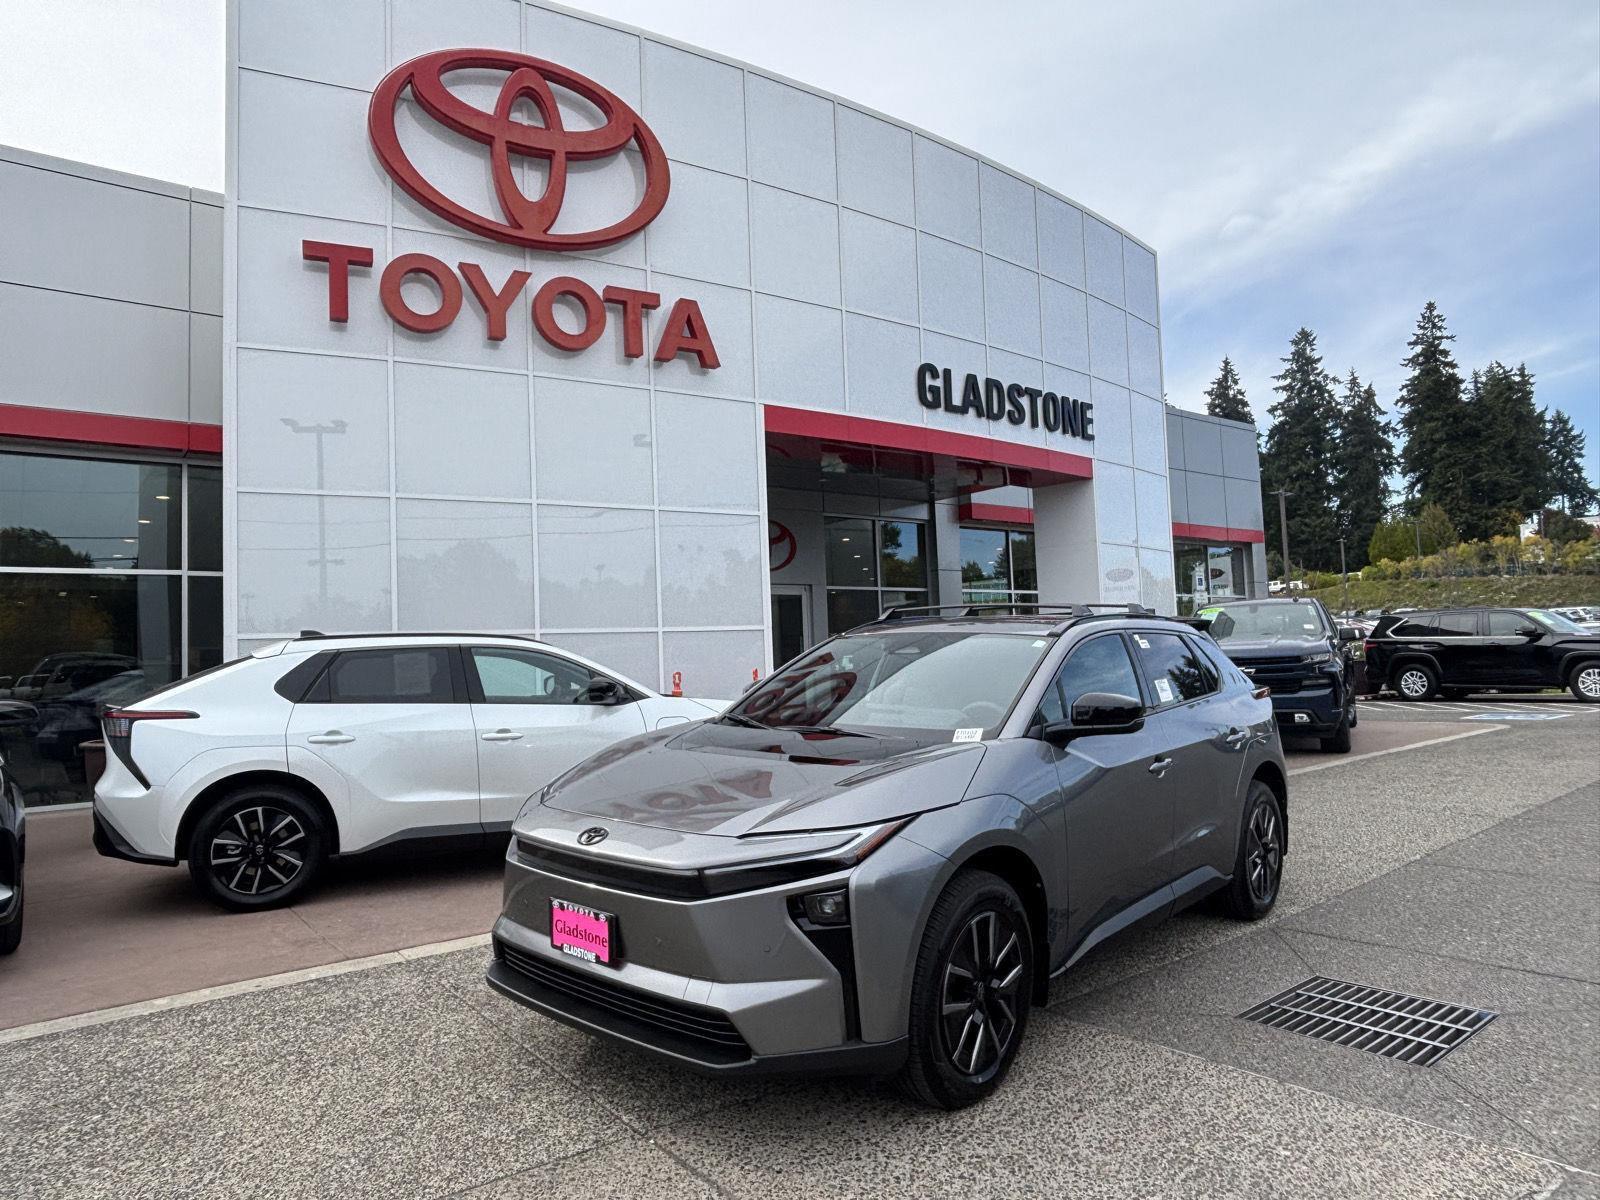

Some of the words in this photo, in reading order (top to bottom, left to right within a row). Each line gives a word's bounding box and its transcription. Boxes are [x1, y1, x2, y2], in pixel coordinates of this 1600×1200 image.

[302, 239, 721, 370] TOYOTA
[917, 362, 1095, 442] GLADSTONE
[563, 903, 595, 918] TOYOTA
[555, 919, 608, 948] Gladstone
[563, 943, 596, 963] GLADSTONE
